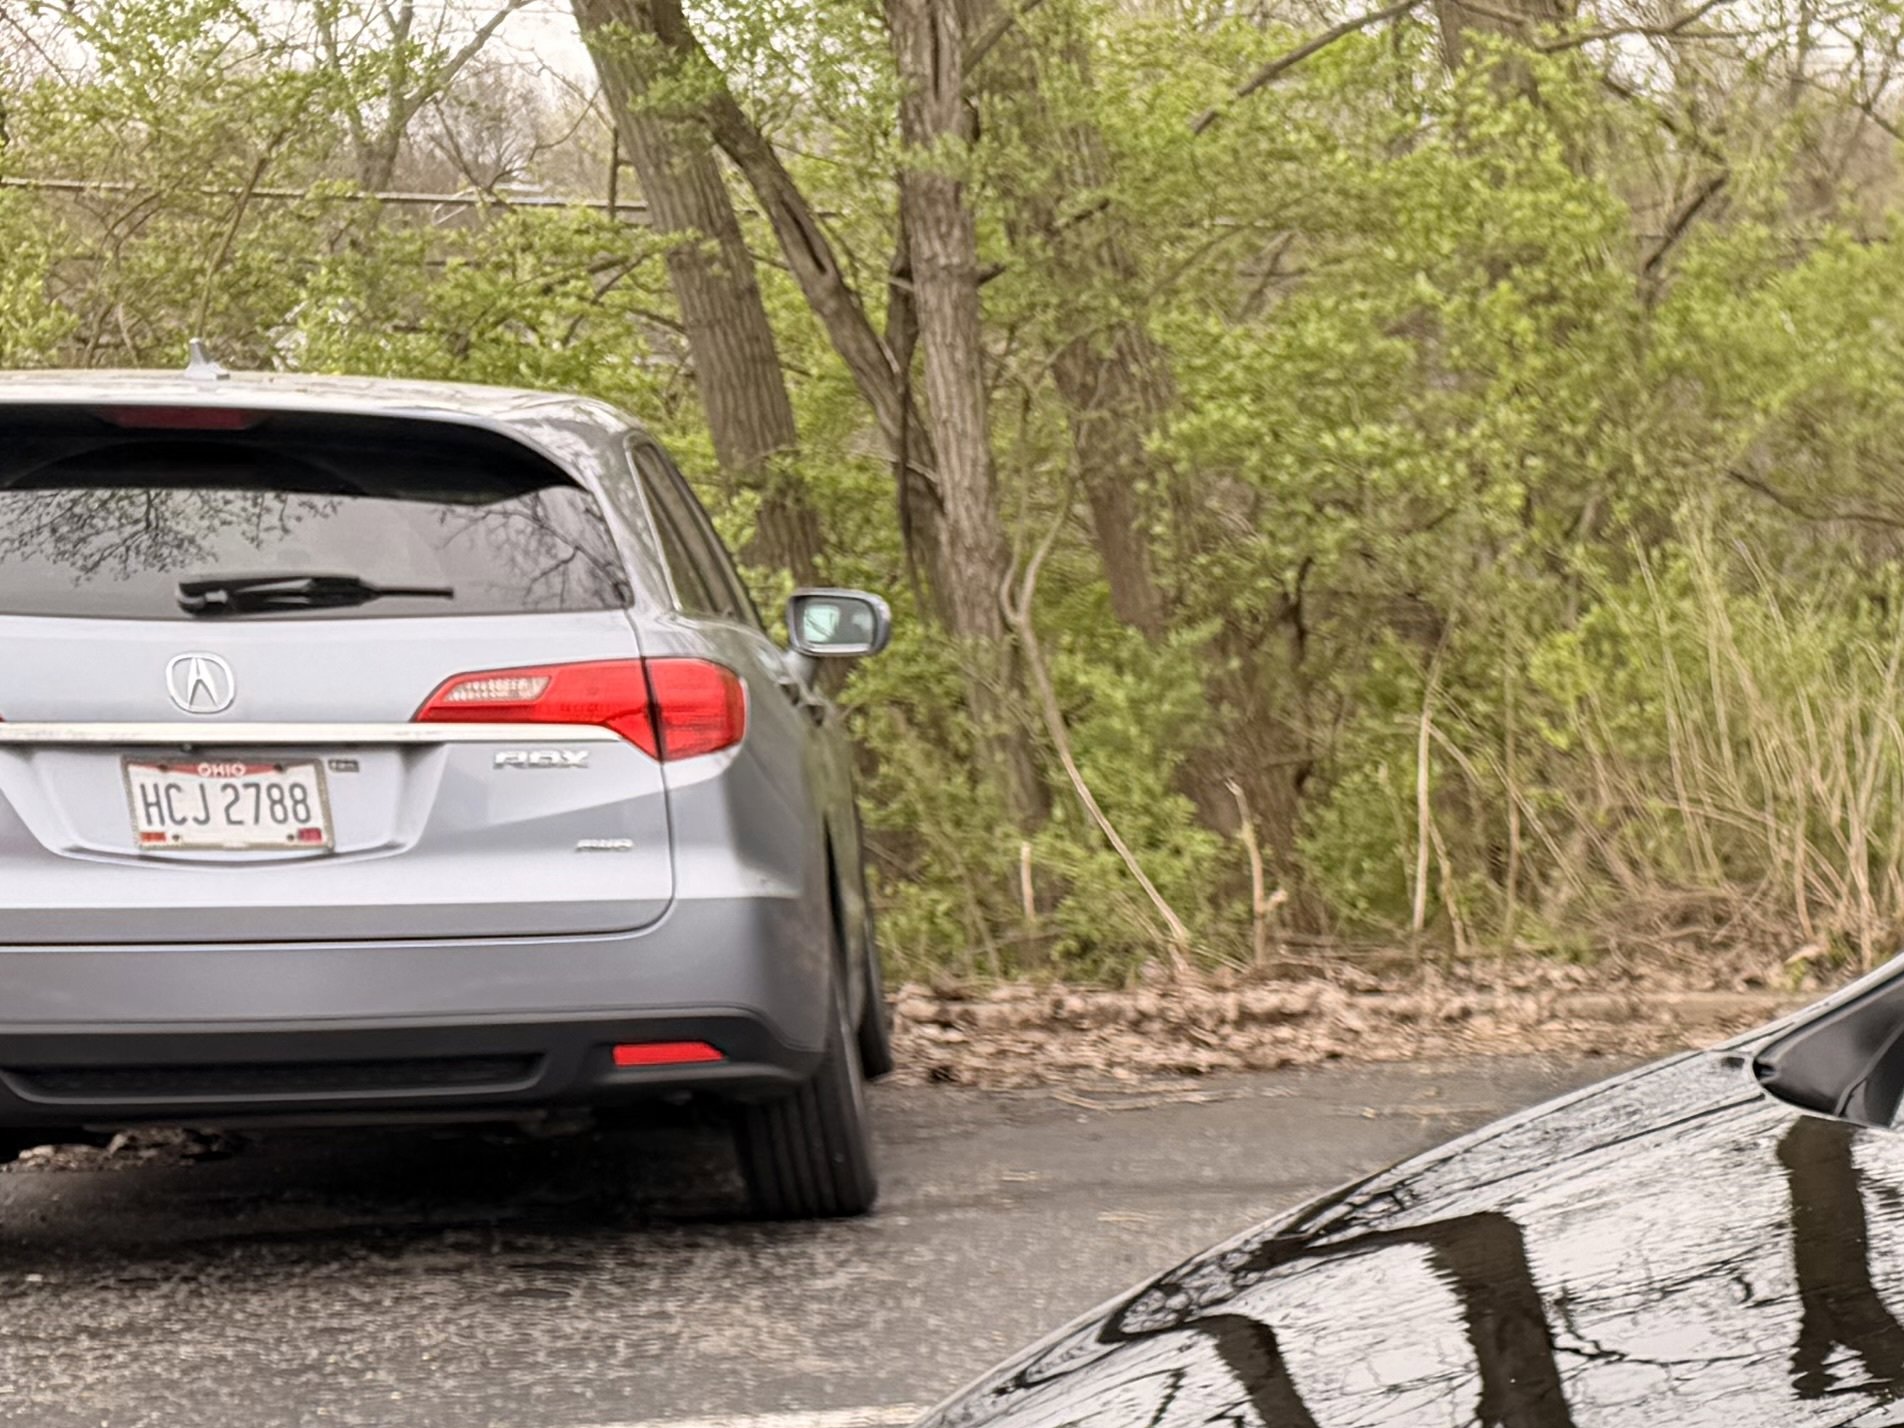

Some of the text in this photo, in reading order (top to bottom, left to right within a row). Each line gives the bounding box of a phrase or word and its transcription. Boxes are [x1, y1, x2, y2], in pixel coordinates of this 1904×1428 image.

[493, 750, 588, 769] RDX
[197, 762, 246, 778] OHIO
[139, 782, 312, 827] HCJ 2788
